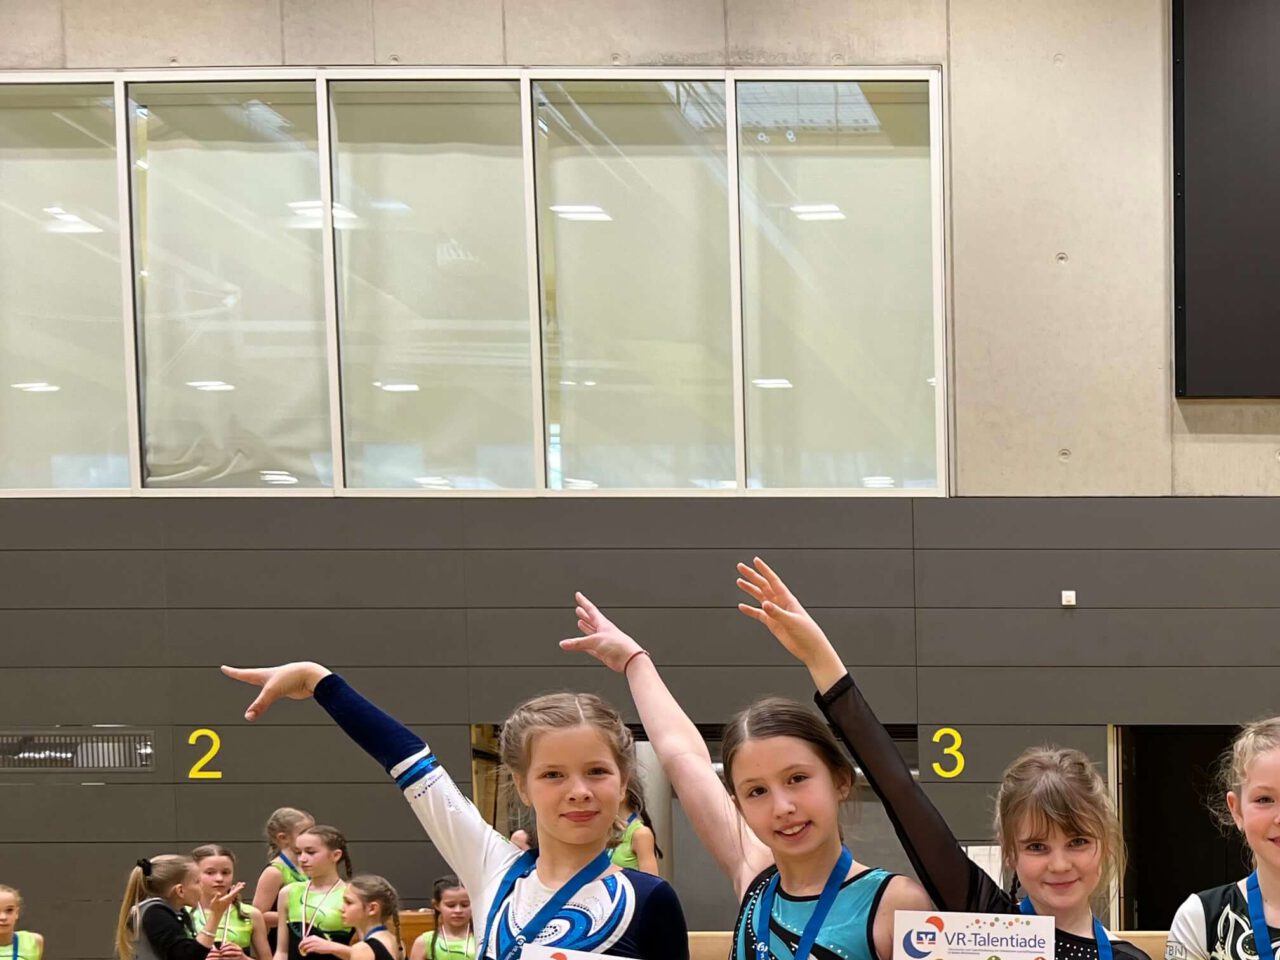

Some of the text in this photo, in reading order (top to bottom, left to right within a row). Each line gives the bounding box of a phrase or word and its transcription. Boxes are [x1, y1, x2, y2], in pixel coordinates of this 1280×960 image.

[188, 729, 222, 778] 2
[932, 728, 965, 778] 3
[945, 932, 1046, 949] VR-Talentiade
